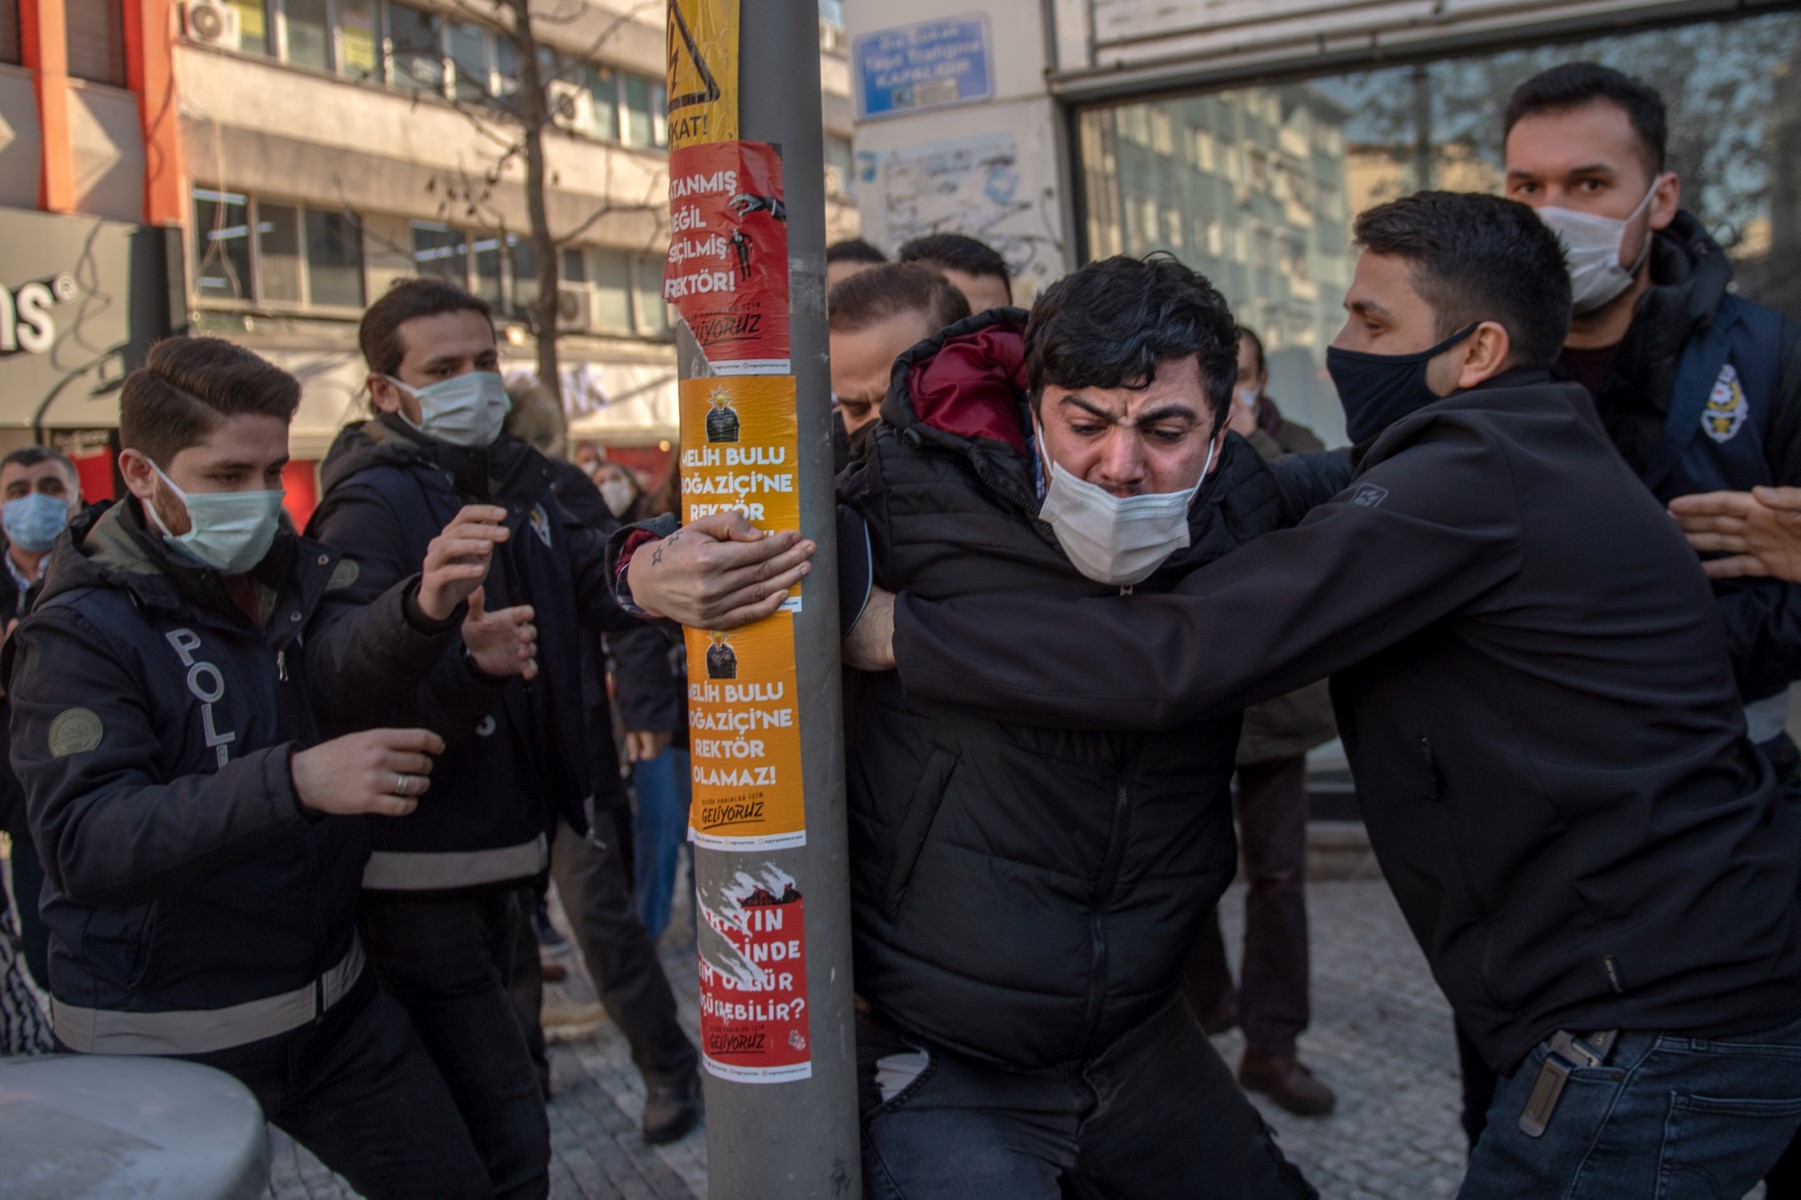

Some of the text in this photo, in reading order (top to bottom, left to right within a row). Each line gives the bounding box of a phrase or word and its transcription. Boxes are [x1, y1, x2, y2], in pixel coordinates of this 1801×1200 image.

[668, 113, 708, 143] KAT!
[671, 204, 707, 233] EĞİL
[726, 446, 785, 466] BULU
[681, 470, 793, 498] OĞAZİÇİ'NE
[688, 680, 784, 703] ELİH BULU
[688, 706, 793, 736] OĞAZİÇİ'NE
[695, 736, 765, 758] REKTÖR
[693, 765, 777, 787] OLAMAZ!
[701, 801, 764, 825] GELİYORUZ
